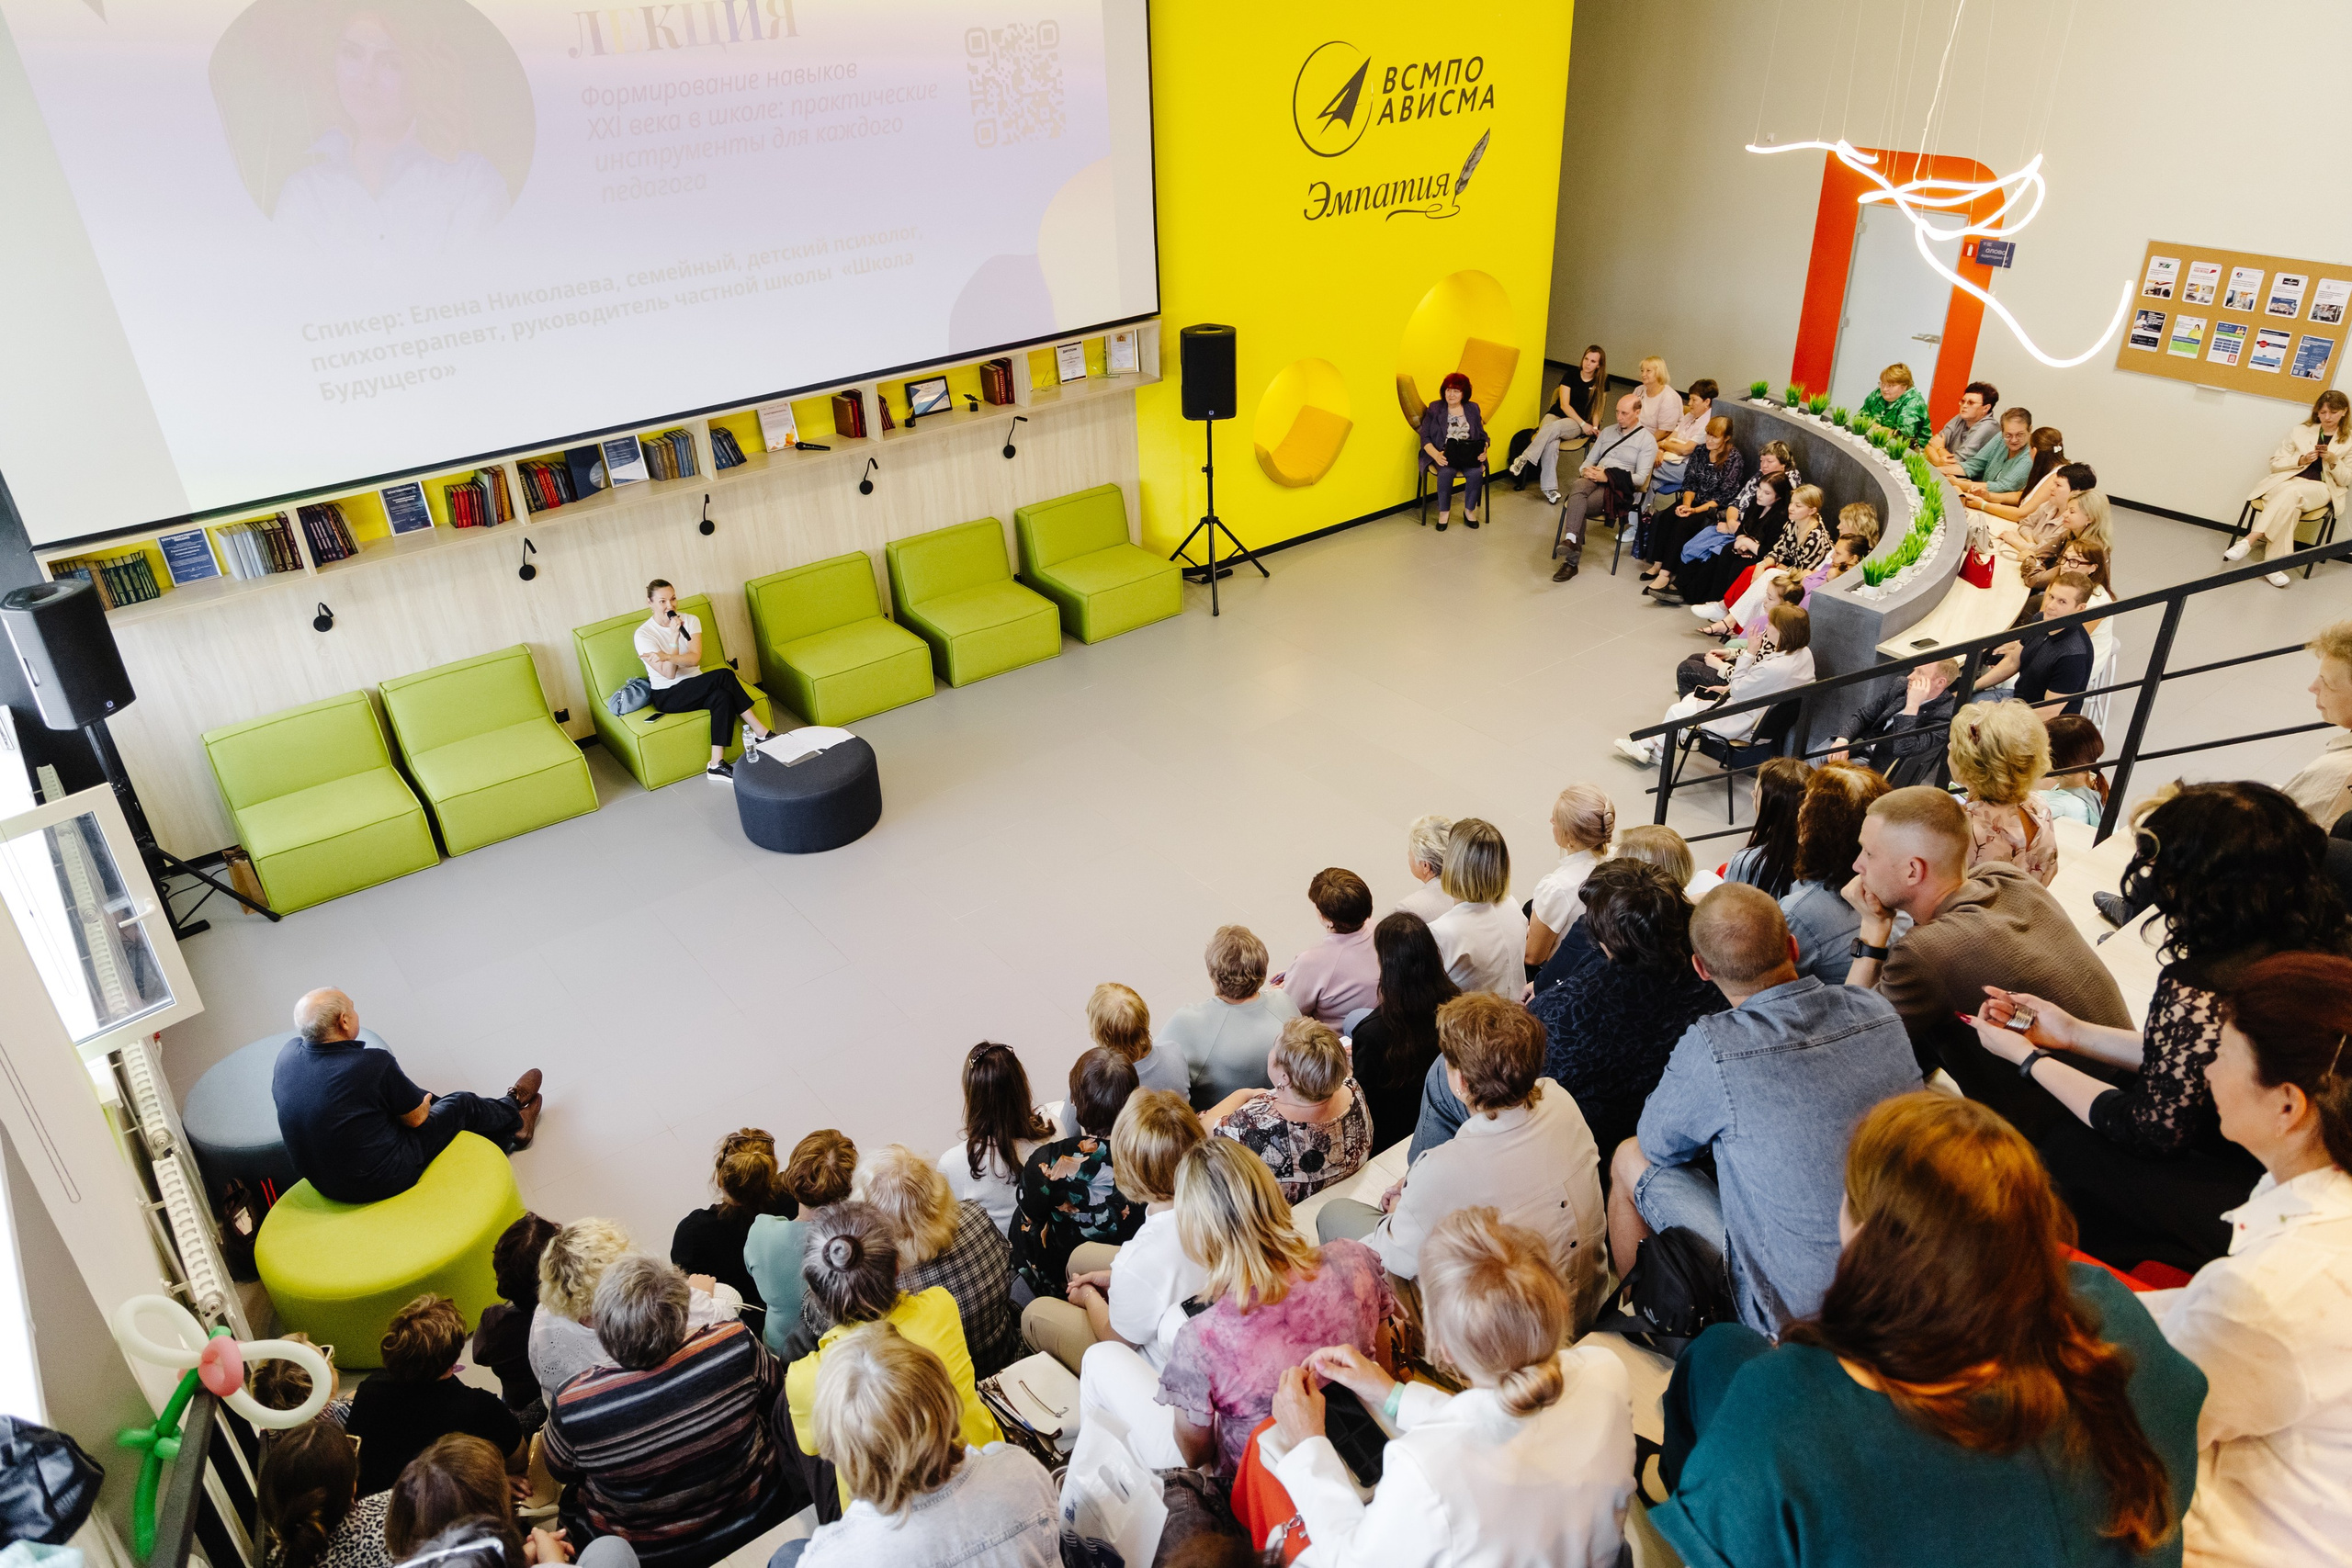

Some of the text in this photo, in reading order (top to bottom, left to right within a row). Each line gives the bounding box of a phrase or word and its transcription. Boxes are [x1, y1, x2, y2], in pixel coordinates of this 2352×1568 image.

[568, 0, 800, 59] ЛЕКЦИЯ
[582, 62, 857, 111] Формирование навыков
[1382, 56, 1484, 95] ВСМПО
[629, 113, 681, 136] века
[689, 110, 701, 129] в
[708, 100, 784, 126] школе:
[791, 83, 938, 120] практические
[1376, 84, 1495, 126] АВИСМА
[594, 115, 904, 172] инструменты для каждого
[602, 173, 707, 204] педагога
[1303, 173, 1451, 220] Эмпатия
[301, 225, 923, 344] Спикер: Елена Николаева, семейный, детский психолог,
[311, 251, 915, 372] психотерапевт, руководитель частной школы «Школа
[319, 364, 458, 404] Будущего»
